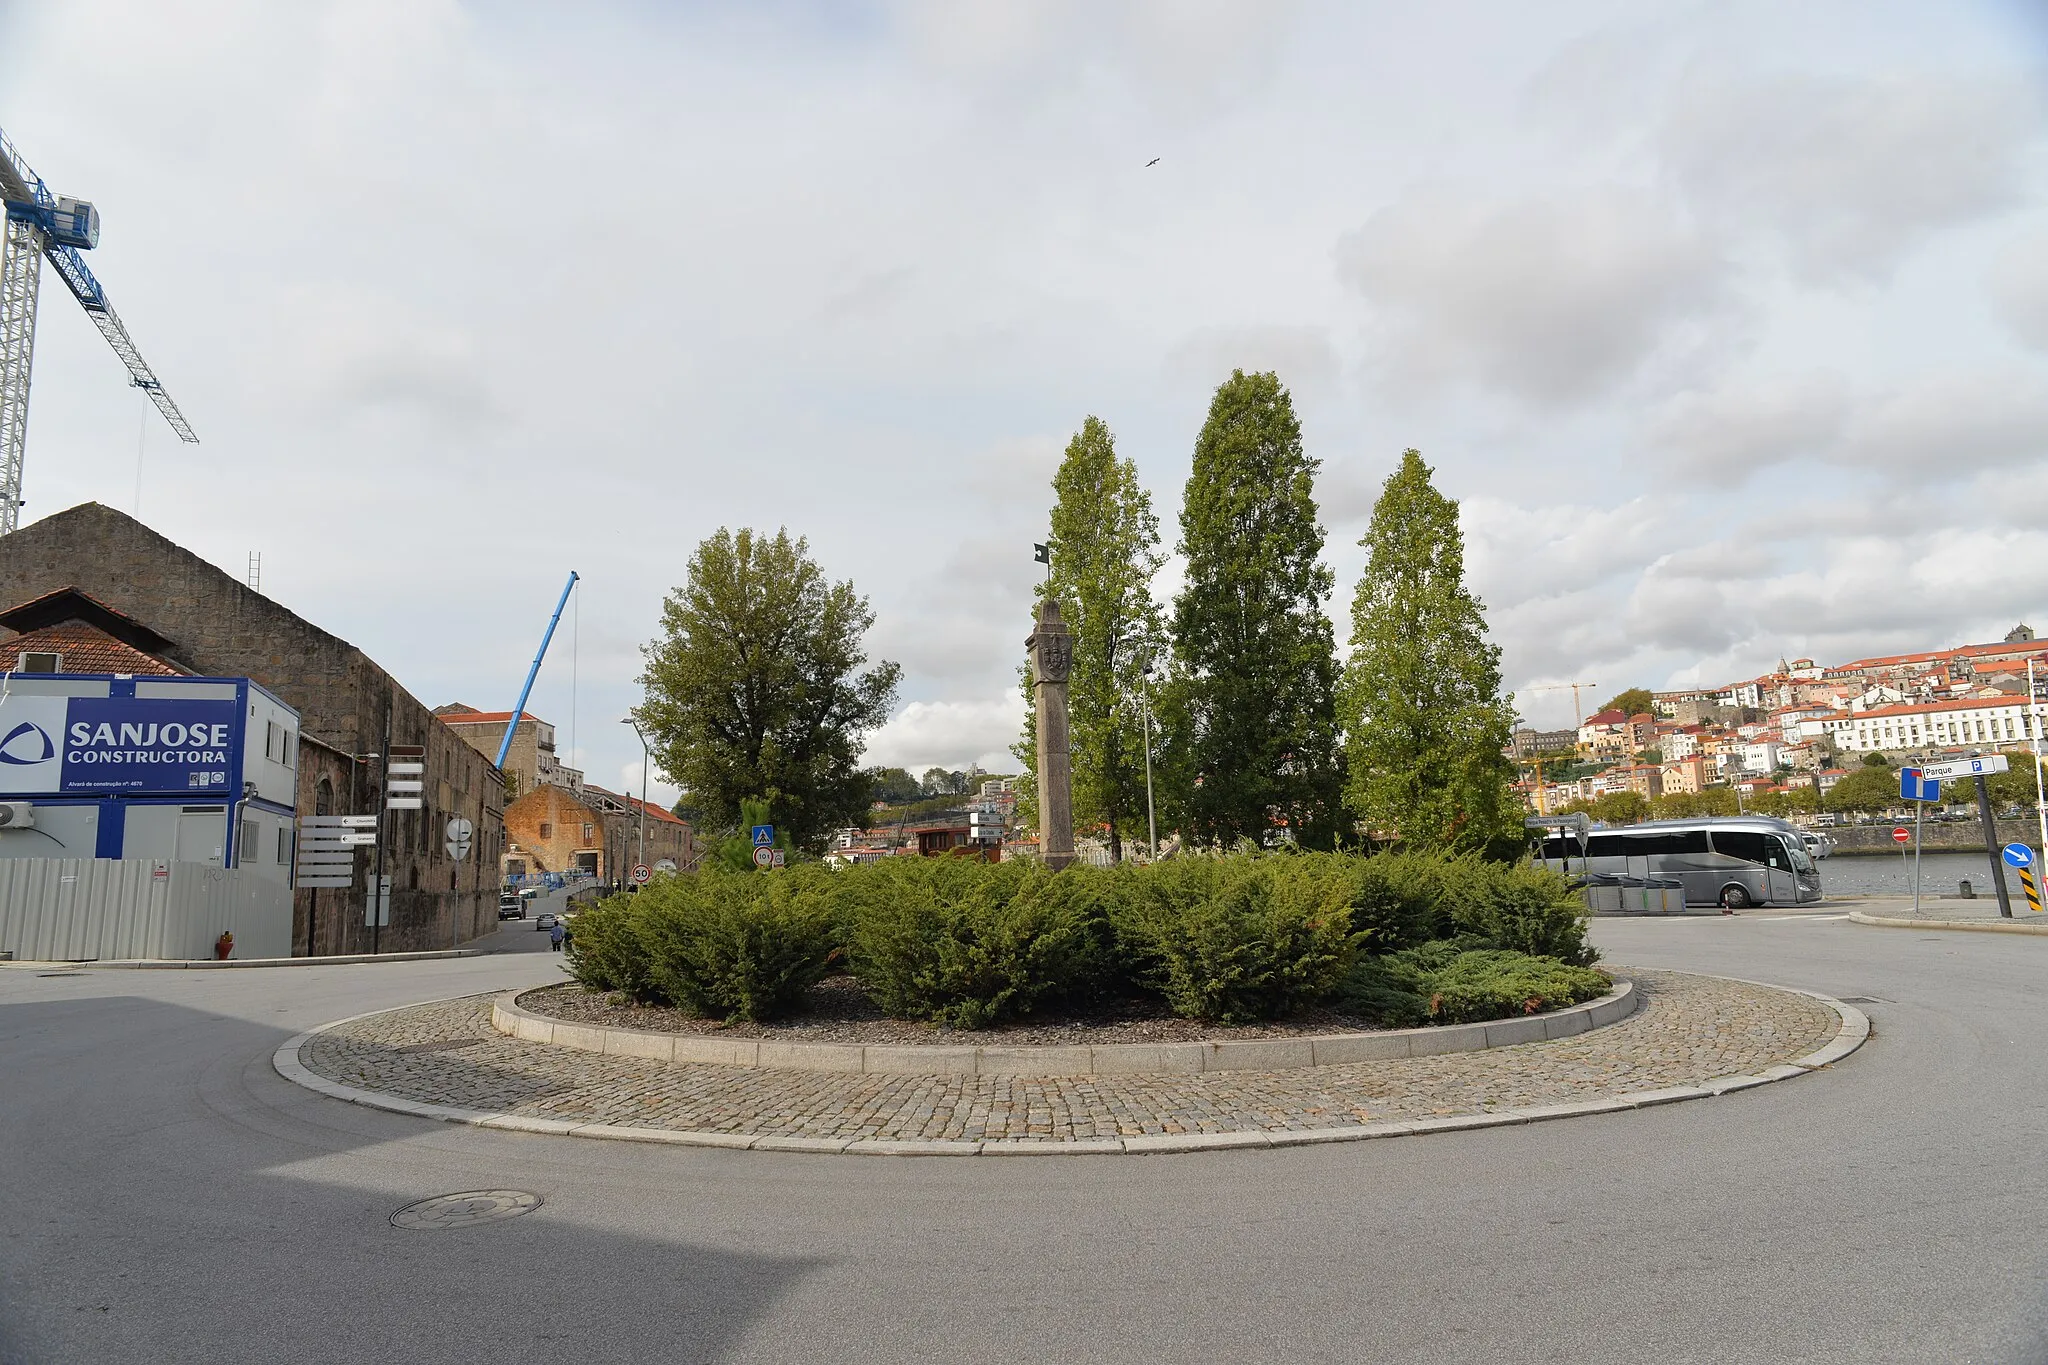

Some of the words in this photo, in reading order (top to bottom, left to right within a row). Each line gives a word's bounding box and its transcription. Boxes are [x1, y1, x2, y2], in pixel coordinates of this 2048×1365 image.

[69, 721, 228, 747] SANJOSE
[67, 750, 226, 764] CONSTRUCTORA
[1925, 767, 1952, 776] Parque
[635, 869, 648, 878] 50
